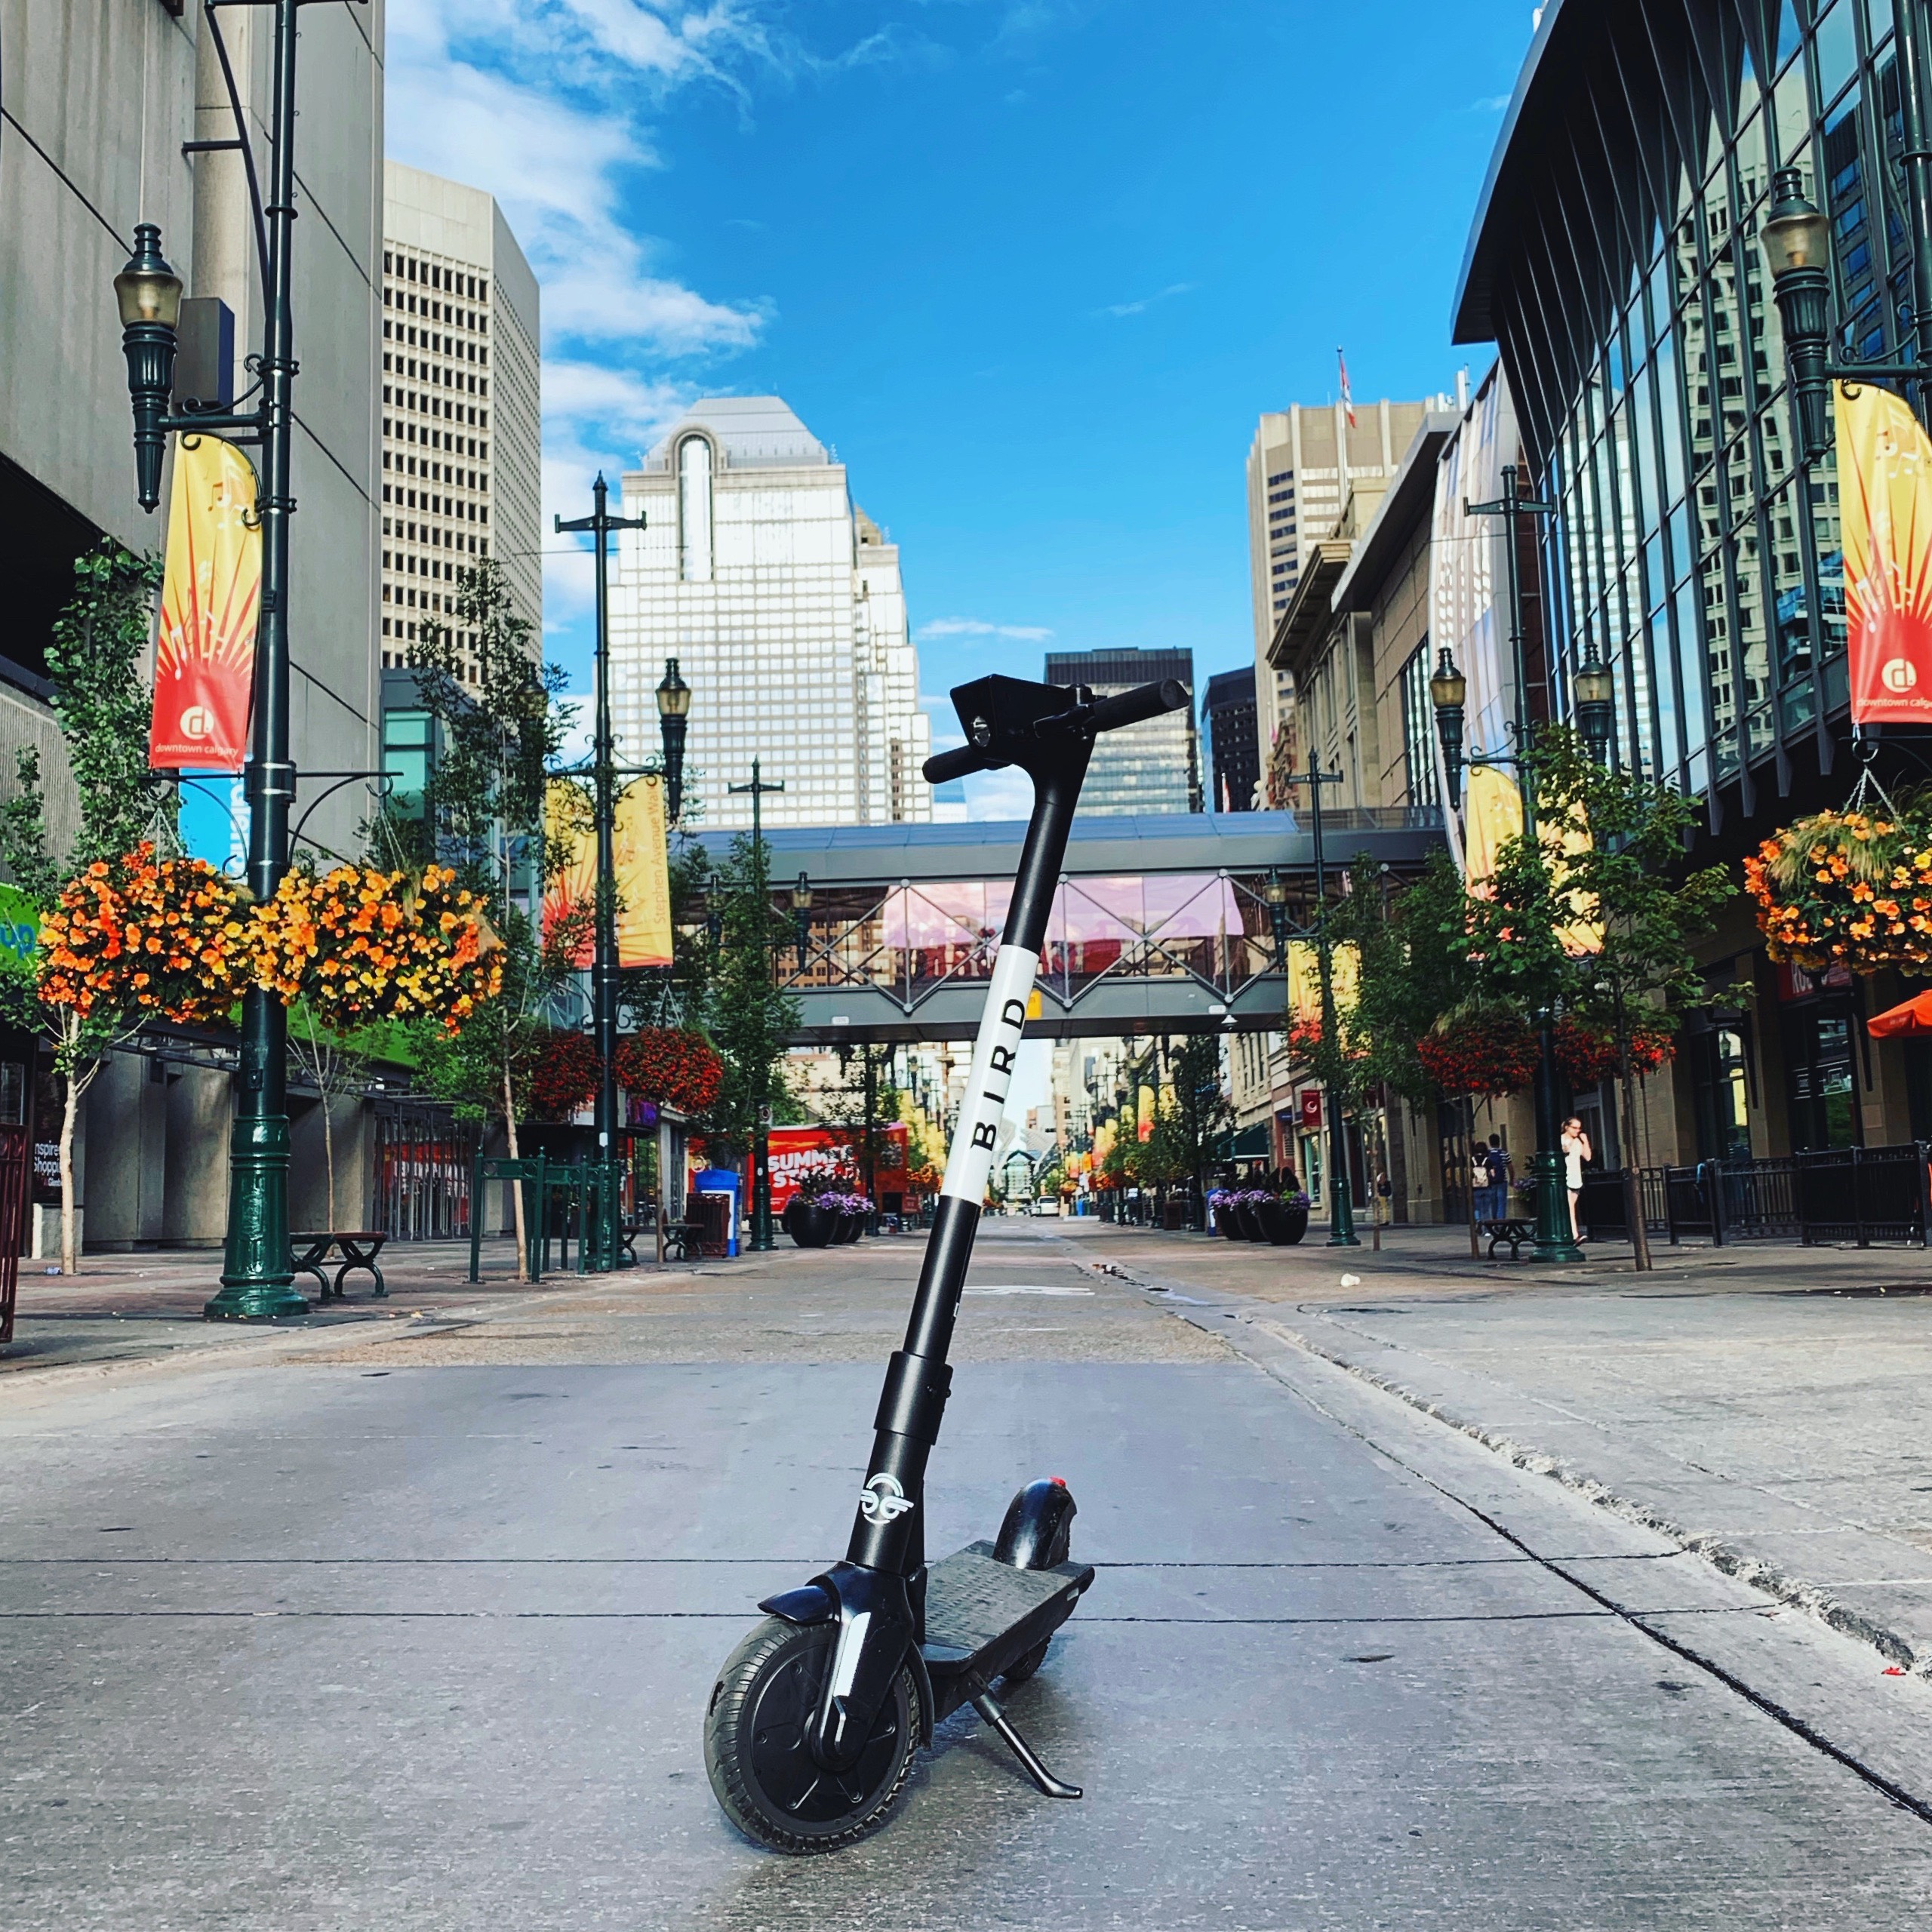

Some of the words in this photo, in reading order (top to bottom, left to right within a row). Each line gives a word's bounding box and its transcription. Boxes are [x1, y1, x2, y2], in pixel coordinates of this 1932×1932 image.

[1857, 698, 1908, 707] downtown
[1909, 697, 1932, 709] calg
[155, 743, 202, 753] downtown
[204, 744, 238, 758] calgary
[647, 785, 659, 816] Wal
[650, 817, 662, 866] Avenue
[653, 871, 666, 924] Stephen
[971, 998, 1026, 1152] BIRD
